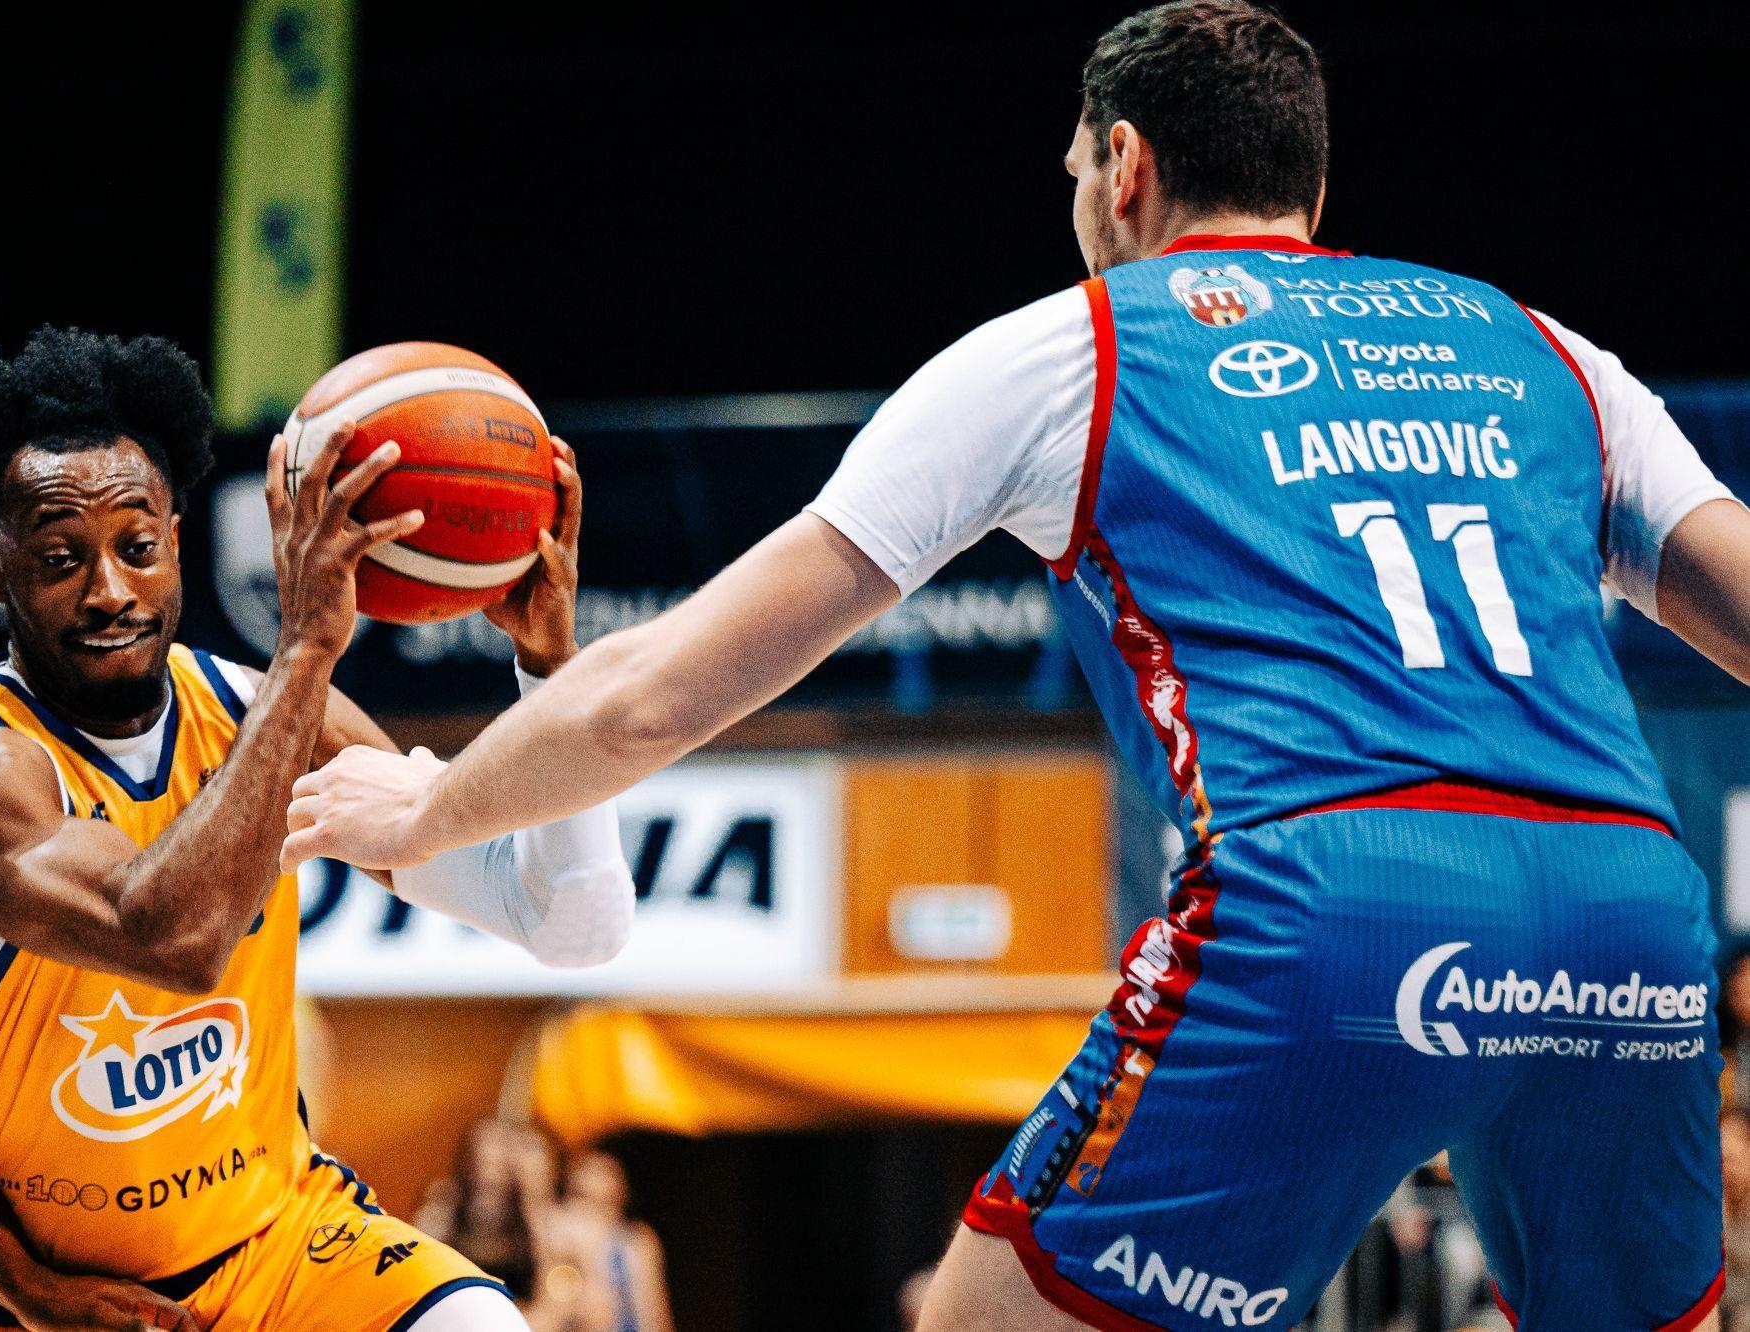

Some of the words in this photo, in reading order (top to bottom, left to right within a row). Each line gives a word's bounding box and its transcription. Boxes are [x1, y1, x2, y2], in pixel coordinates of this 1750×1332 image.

[1276, 277, 1448, 293] MIASTO
[1288, 292, 1493, 325] TORUŃ
[1338, 339, 1458, 366] Toyota
[1352, 368, 1526, 400] Bednarscy
[1261, 415, 1519, 487] LANGOVIĆ
[1330, 500, 1533, 677] 11
[105, 1024, 223, 1109] LOTTO
[1477, 1035, 1602, 1059] TRANSPORT
[116, 1147, 246, 1212] GDYNIA
[1092, 1234, 1289, 1327] ANIRO
